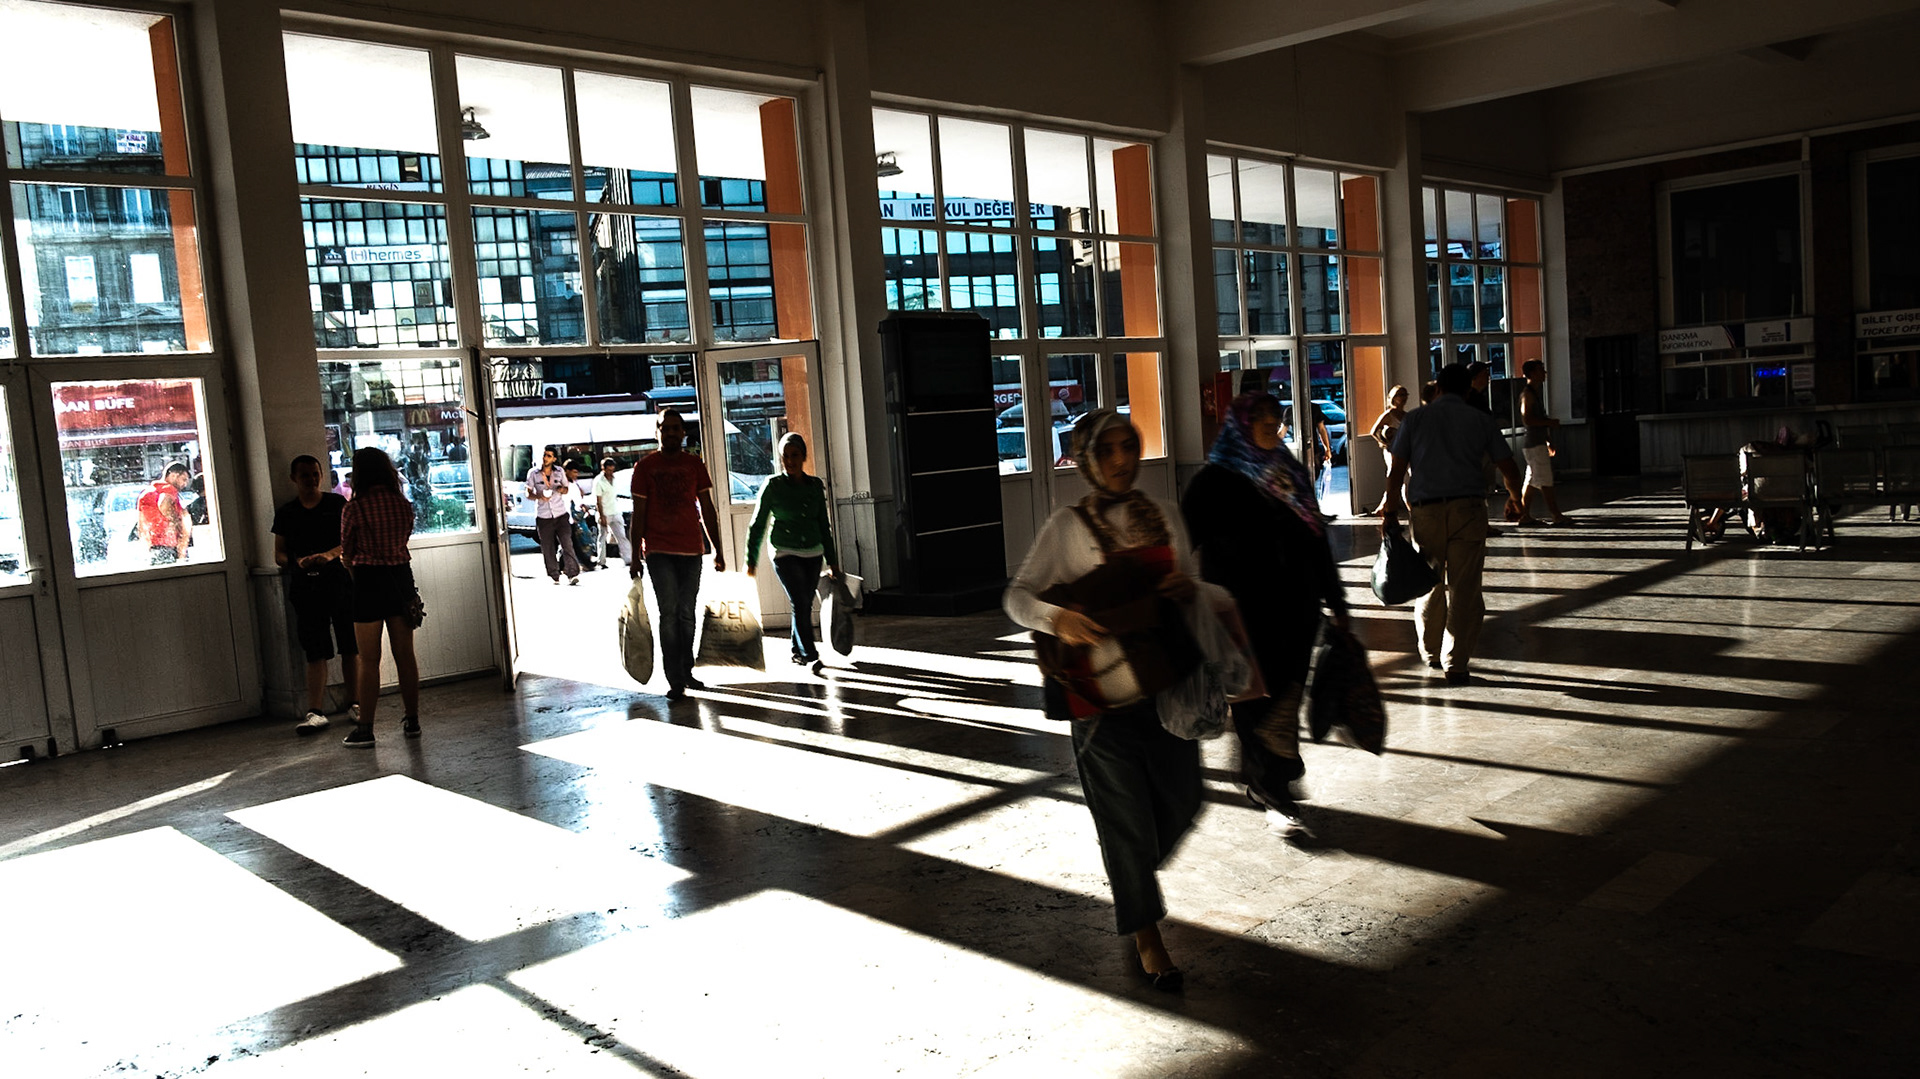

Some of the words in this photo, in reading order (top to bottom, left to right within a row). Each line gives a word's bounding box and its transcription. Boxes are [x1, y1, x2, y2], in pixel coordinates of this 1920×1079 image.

[1862, 315, 1892, 324] BİLET
[1662, 340, 1713, 350] INFORMATION
[94, 397, 135, 410] BÜFE
